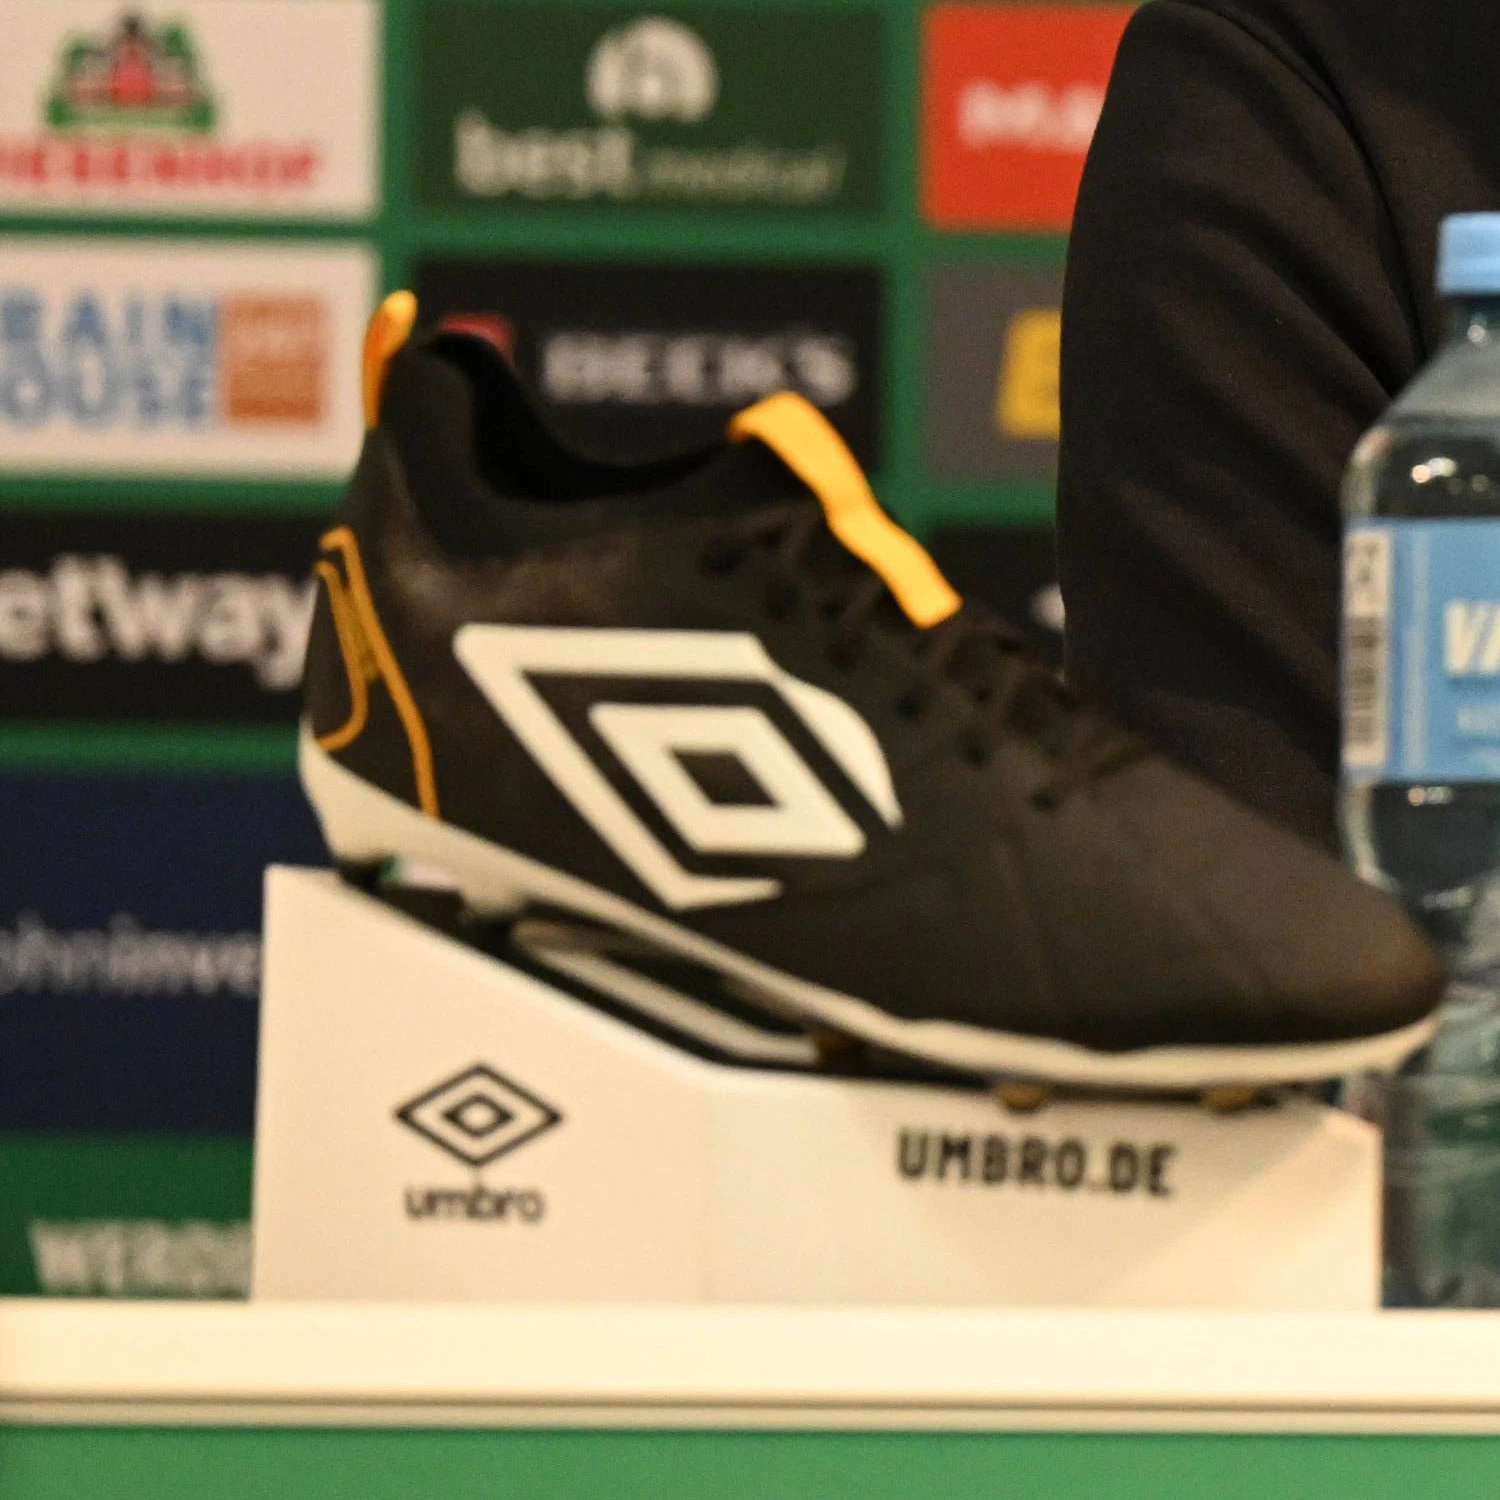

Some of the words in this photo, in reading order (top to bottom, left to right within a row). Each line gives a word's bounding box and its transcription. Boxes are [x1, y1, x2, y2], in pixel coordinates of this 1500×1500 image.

[0, 142, 315, 192] IESENHOF
[0, 292, 216, 348] RAIN
[0, 356, 216, 428] OUSE
[0, 556, 317, 688] etway
[896, 1126, 1178, 1197] UMBRO.DE
[404, 1185, 546, 1224] umbro
